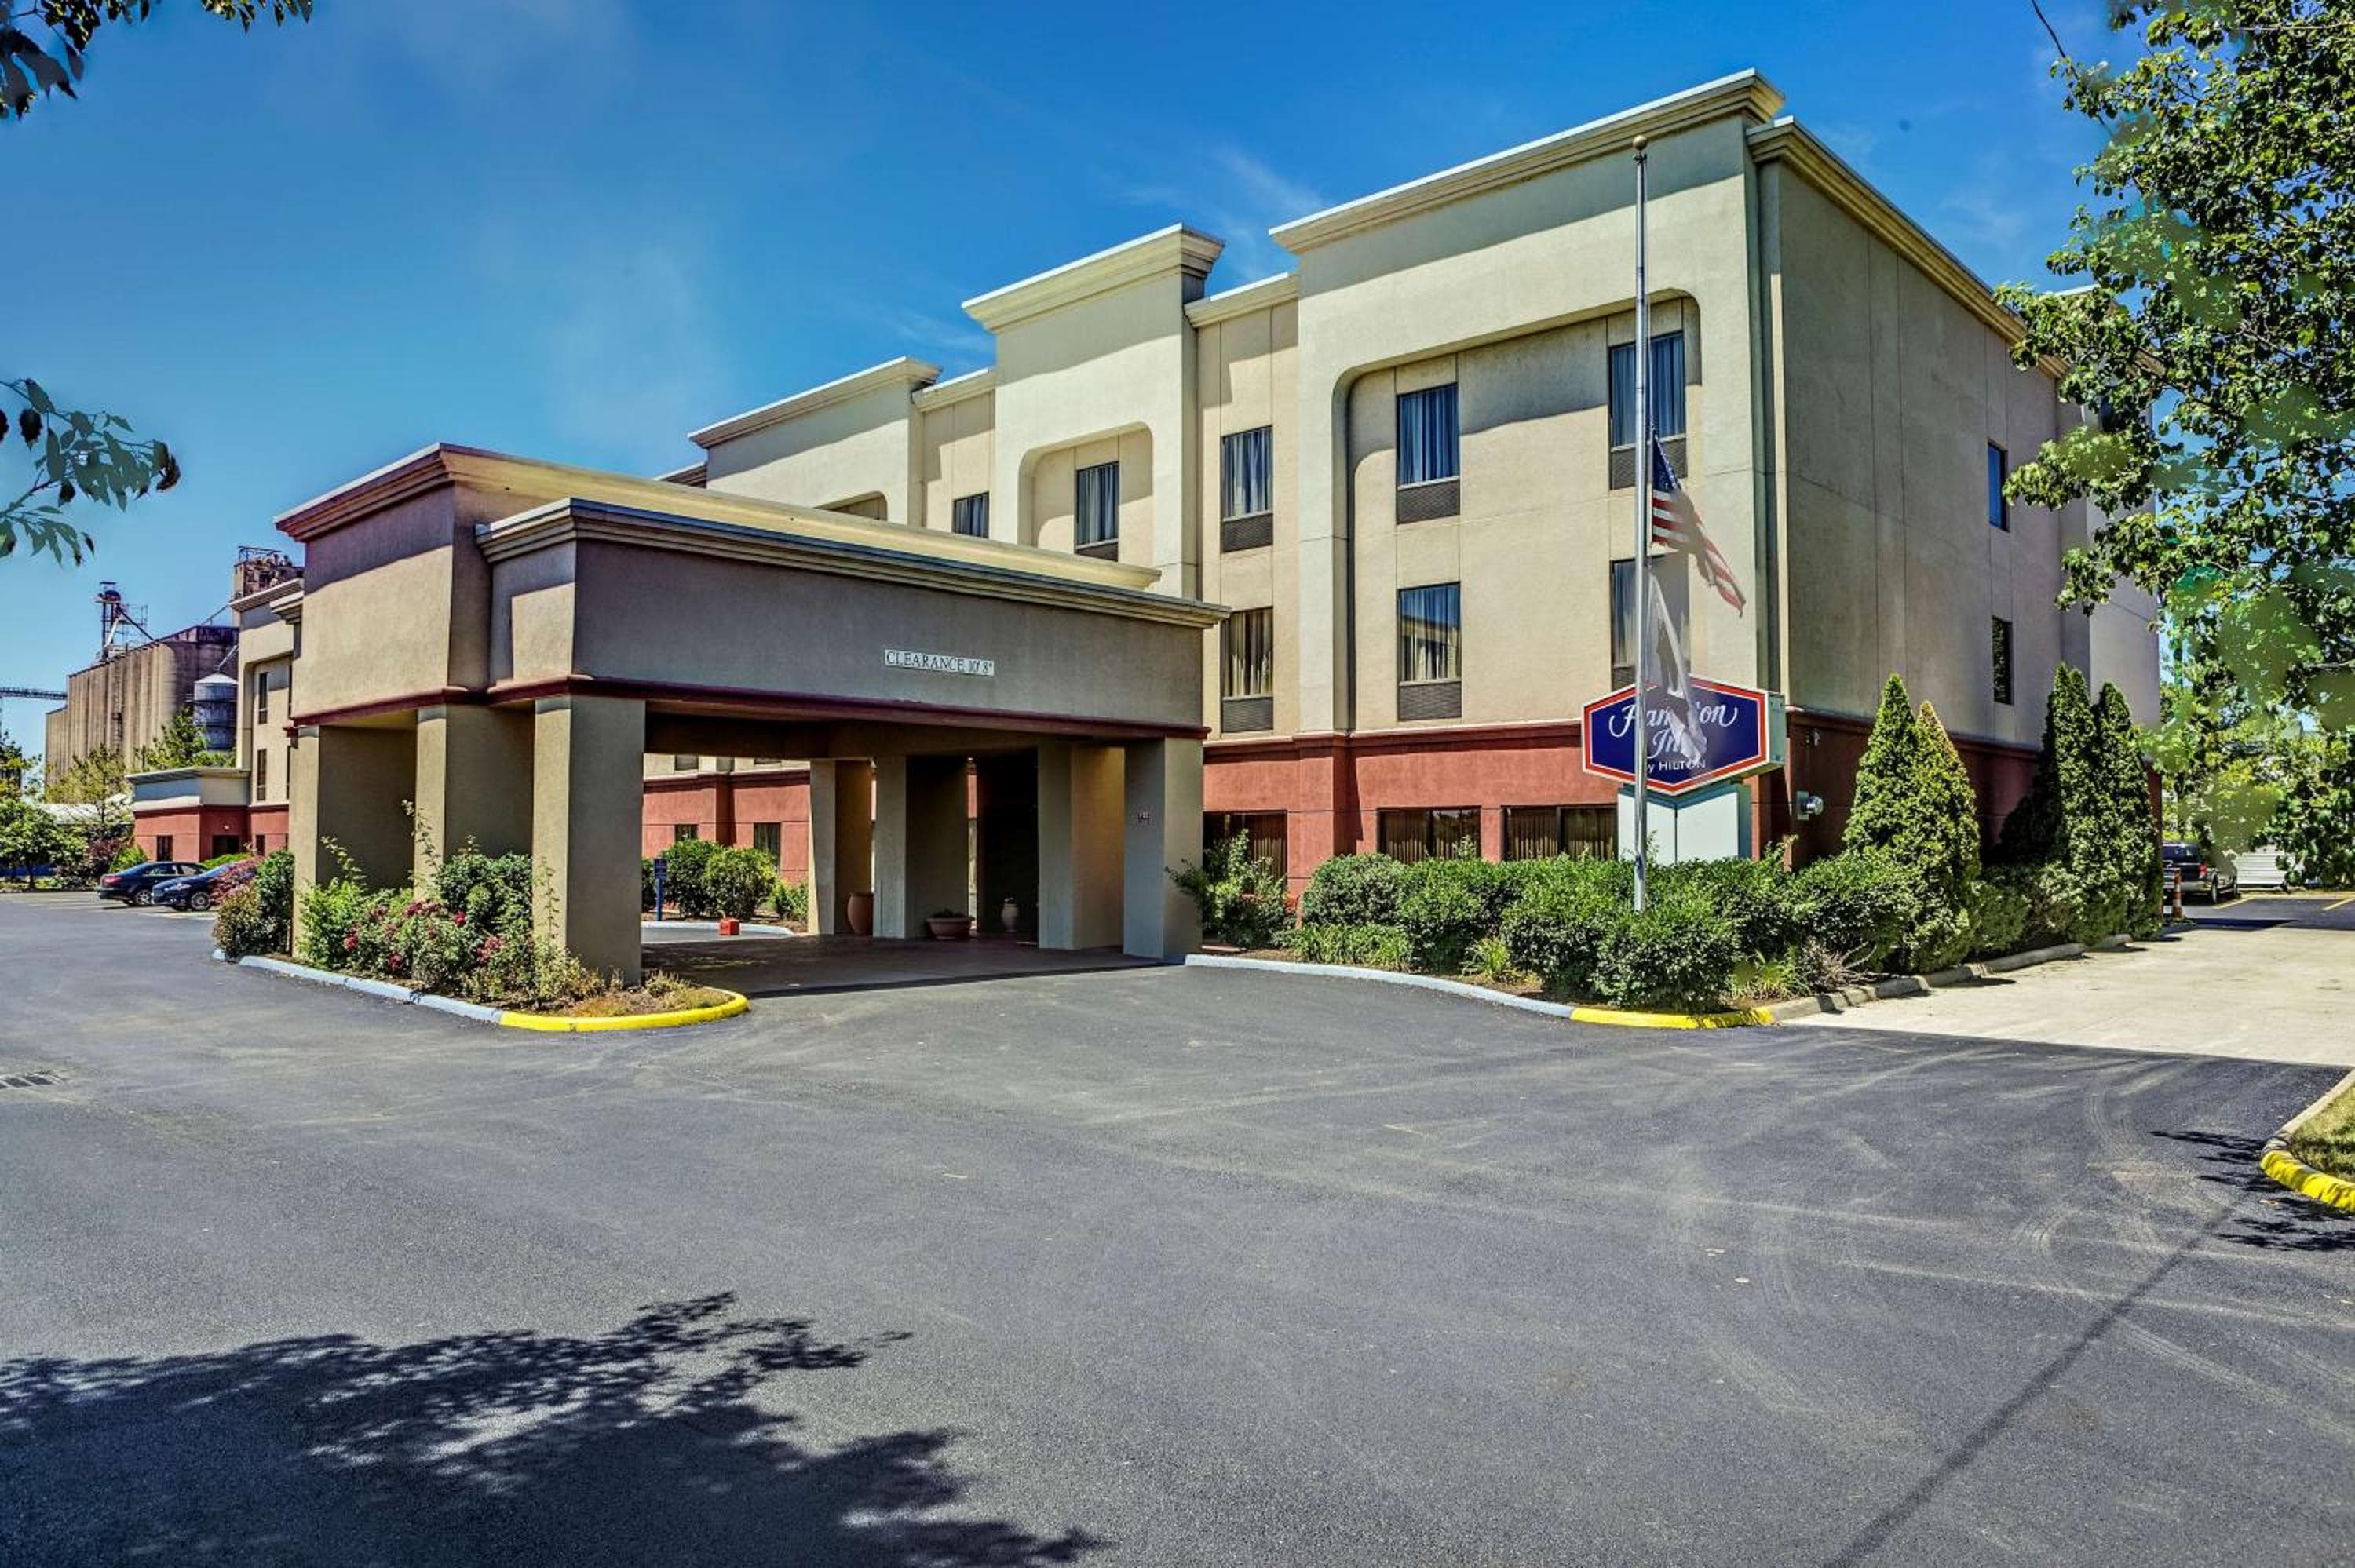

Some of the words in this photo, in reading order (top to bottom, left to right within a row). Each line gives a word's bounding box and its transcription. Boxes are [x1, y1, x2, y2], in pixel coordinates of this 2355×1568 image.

[886, 651, 965, 673] CLEARANCE
[1647, 727, 1689, 759] In
[1659, 759, 1706, 771] HILTON
